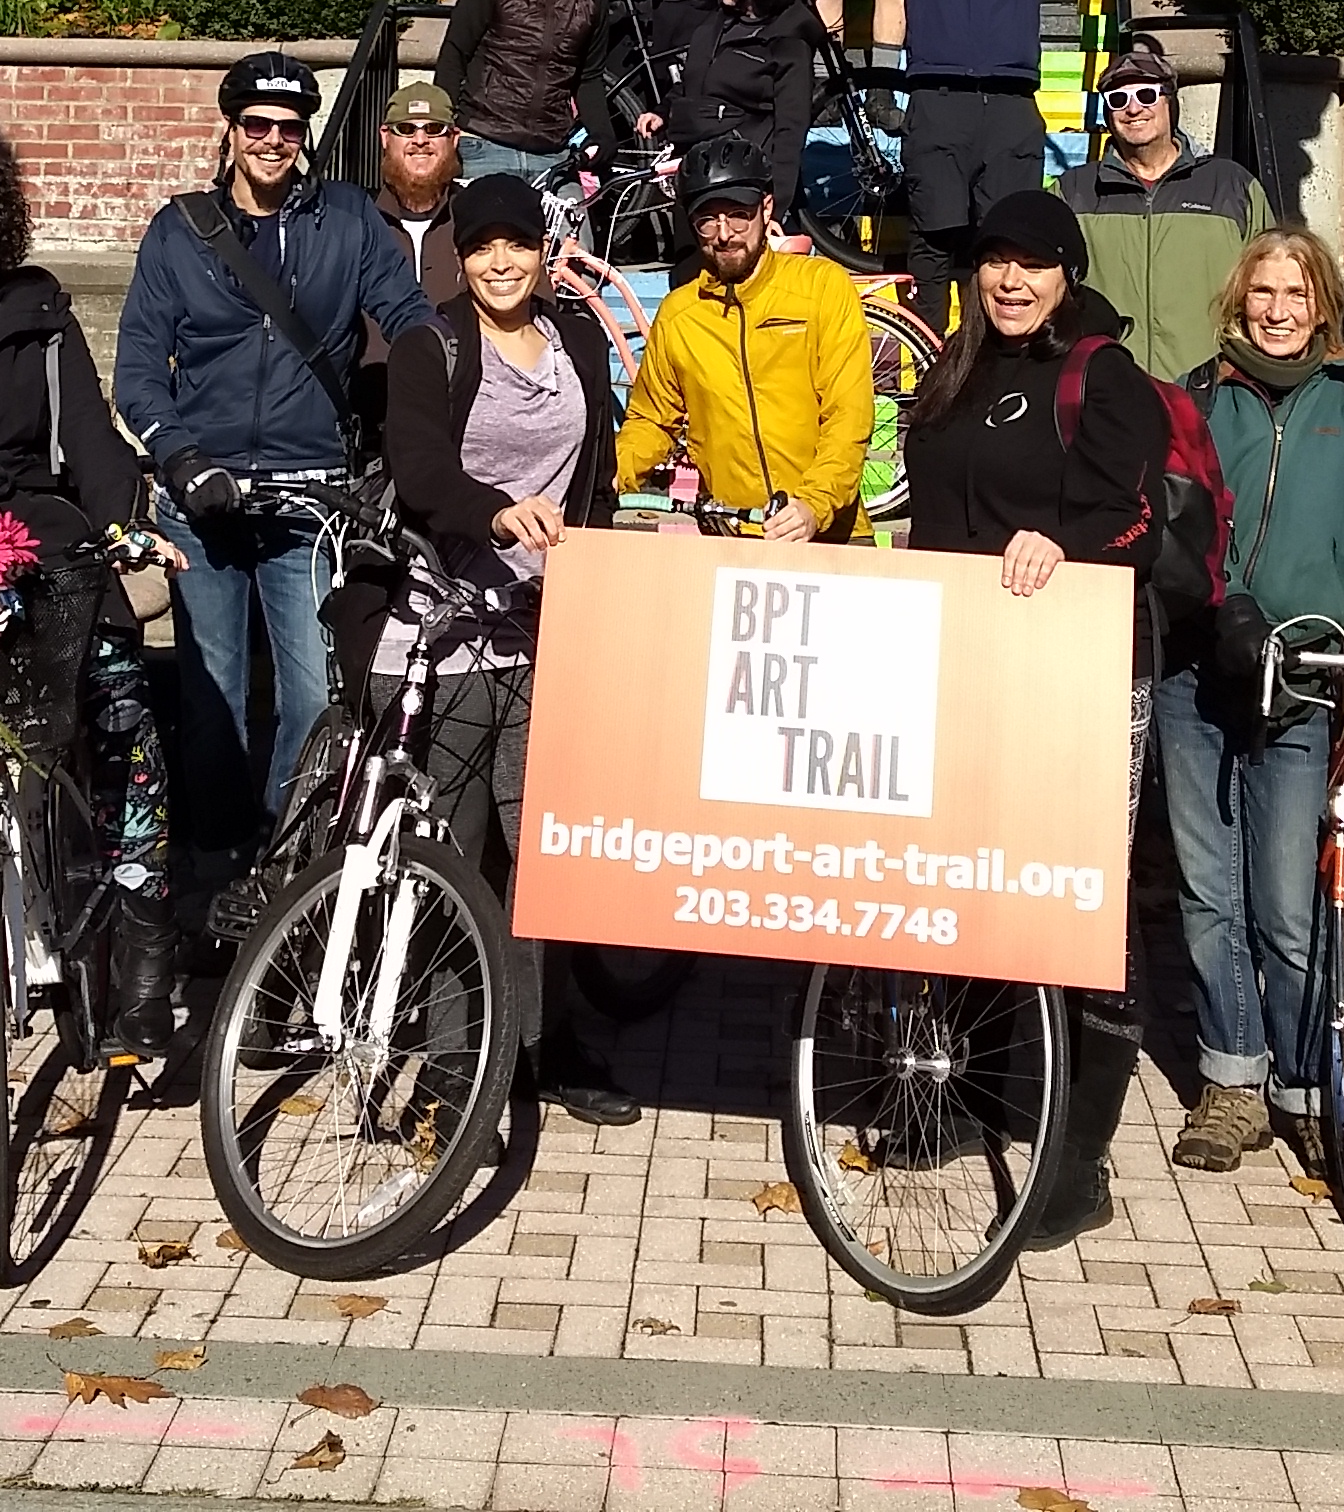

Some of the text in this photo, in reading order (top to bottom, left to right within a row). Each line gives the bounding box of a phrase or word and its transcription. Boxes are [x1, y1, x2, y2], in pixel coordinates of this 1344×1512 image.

[730, 579, 821, 646] BPT
[725, 650, 818, 720] ART
[778, 727, 909, 803] TRAIL
[539, 812, 1105, 911] bridgeport-art-trail.org
[673, 886, 958, 946] 203.334.7748
